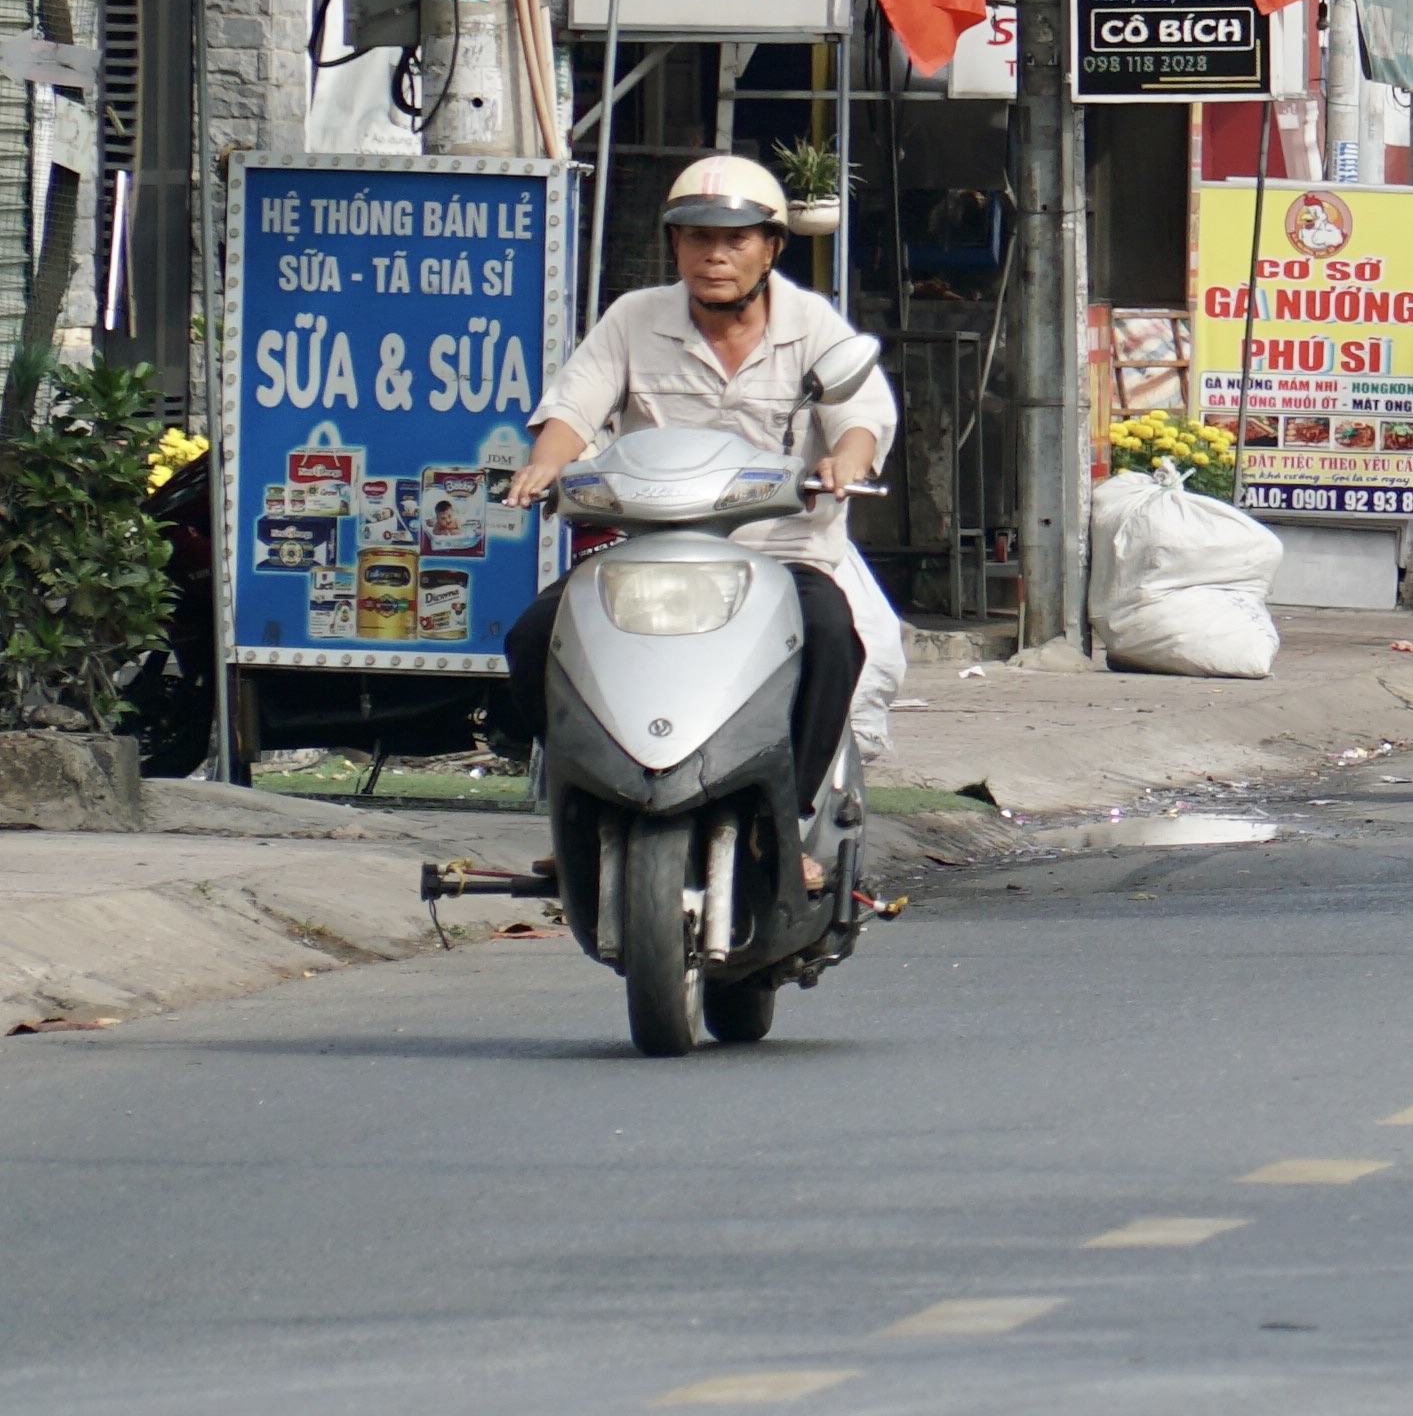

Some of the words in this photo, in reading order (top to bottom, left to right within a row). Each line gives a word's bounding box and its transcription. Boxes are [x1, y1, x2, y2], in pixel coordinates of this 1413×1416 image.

[1101, 14, 1149, 43] CÔ
[1159, 14, 1242, 43] BÍCH
[1083, 55, 1121, 73] 098
[1126, 55, 1151, 73] 118
[261, 190, 300, 242] HỆ
[310, 187, 413, 237] THỐNG
[422, 194, 488, 239] BÁN
[497, 192, 534, 240] LẺ
[278, 248, 342, 292] SỮA
[372, 250, 411, 294] TÃ
[420, 251, 473, 296] GIÁ
[482, 248, 514, 296] SỈ
[1256, 257, 1312, 280] CƠ
[1325, 256, 1383, 282] SỞ
[1204, 282, 1262, 319] GÀ
[256, 312, 359, 409] SỮA
[375, 332, 413, 411] &
[428, 316, 532, 413] SỮA
[1242, 335, 1326, 372] PHÚ
[1340, 336, 1382, 373] SĨ
[1385, 399, 1413, 413] ONG
[1319, 456, 1357, 471] THEO
[1362, 455, 1391, 472] YÊU
[1292, 488, 1337, 510] 0901
[1344, 490, 1368, 512] 92
[1373, 491, 1398, 512] 93
